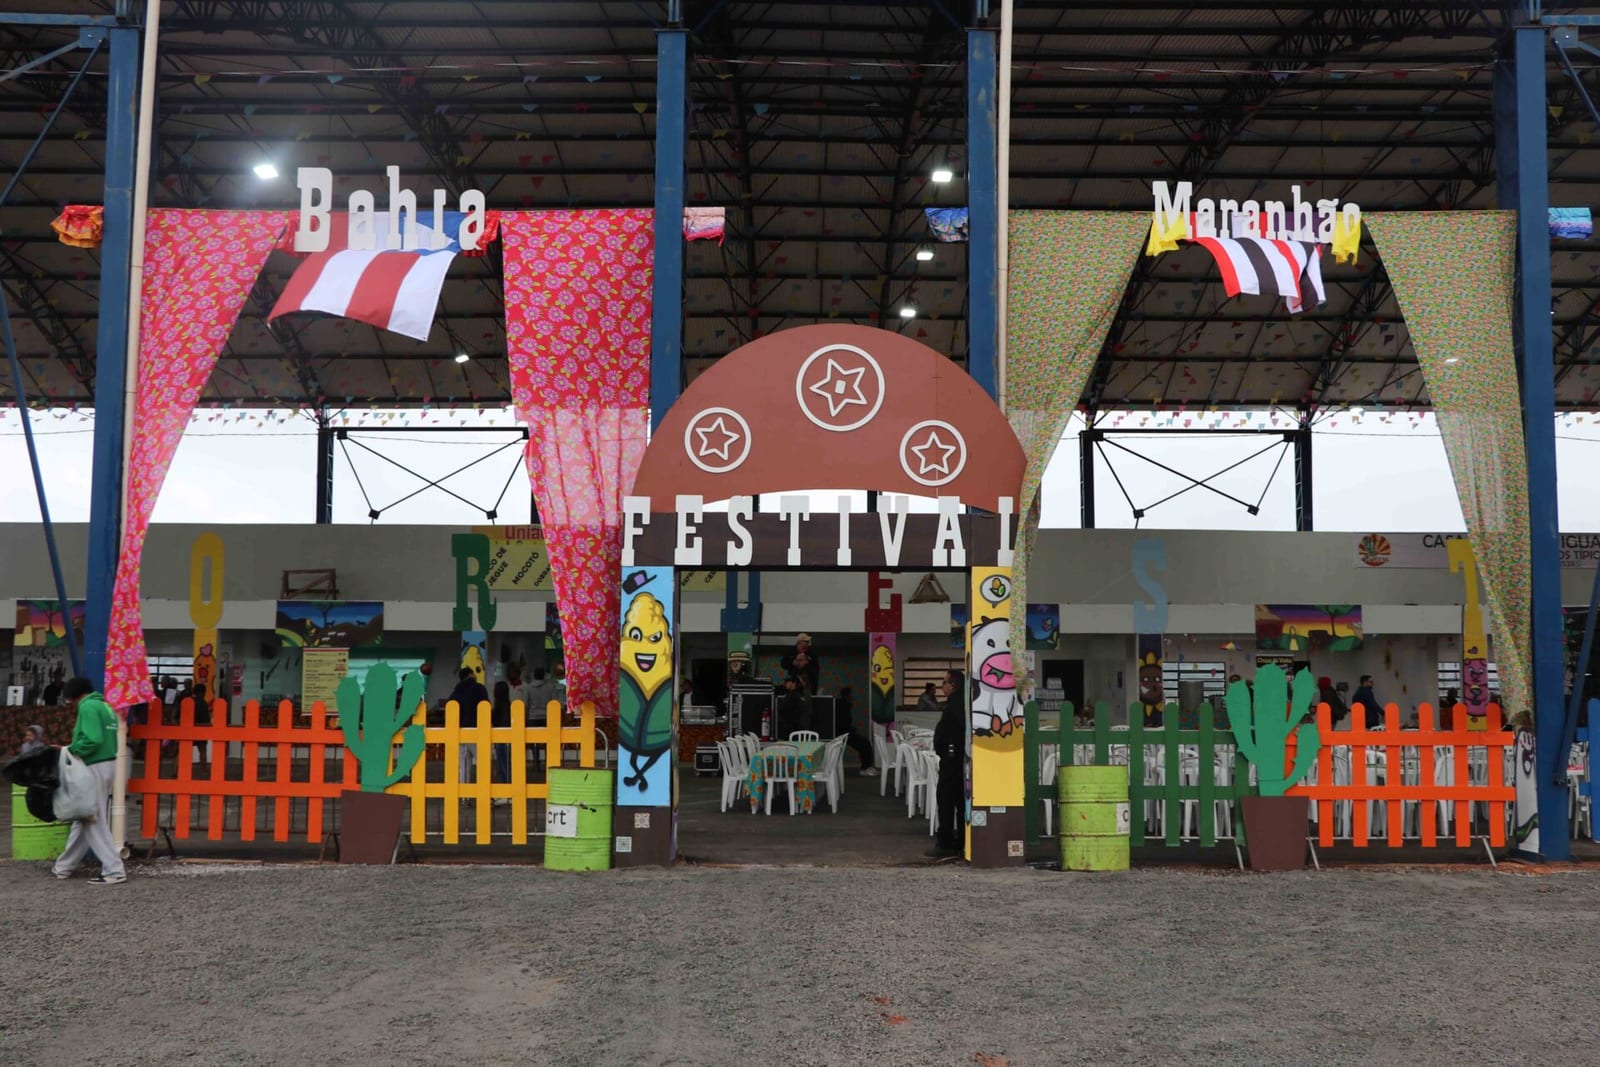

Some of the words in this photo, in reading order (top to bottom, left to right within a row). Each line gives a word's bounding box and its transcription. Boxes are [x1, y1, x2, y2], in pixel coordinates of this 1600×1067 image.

[294, 165, 487, 252] Bahia
[1152, 180, 1361, 244] Maranhão
[621, 494, 1015, 567] FESTIVAL
